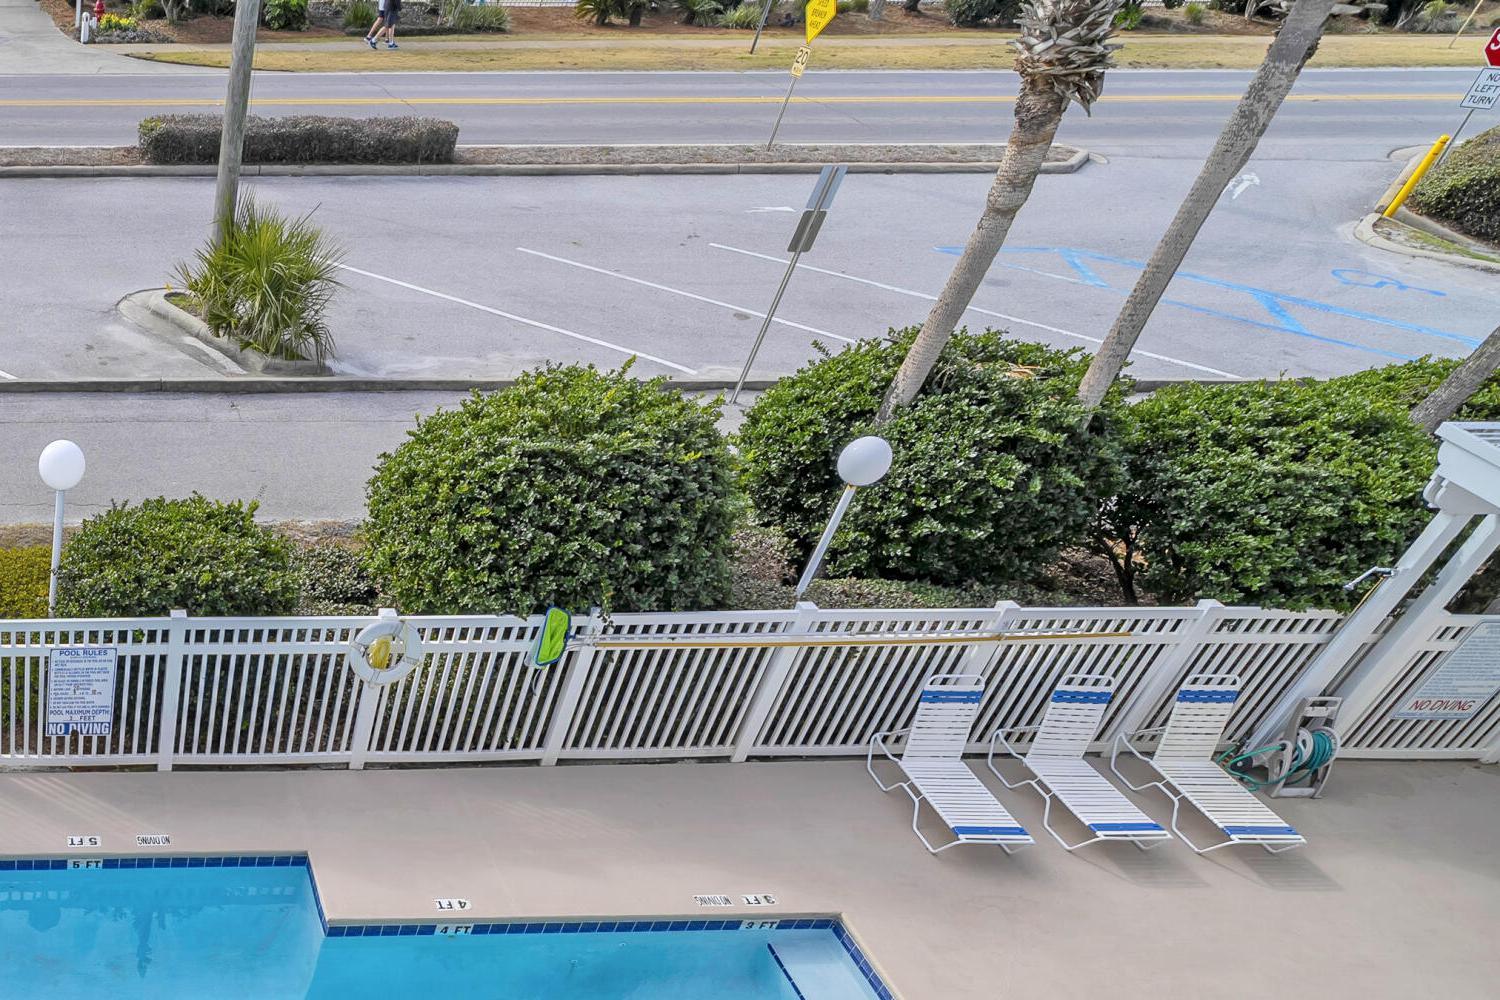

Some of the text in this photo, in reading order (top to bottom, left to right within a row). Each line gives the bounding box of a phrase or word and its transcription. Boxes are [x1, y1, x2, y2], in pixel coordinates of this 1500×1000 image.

[795, 49, 809, 65] 20
[1486, 73, 1500, 82] NO
[1474, 84, 1500, 94] LEFT
[1468, 95, 1494, 105] TURN
[1408, 699, 1477, 711] NO DIVING
[49, 722, 110, 735] NO DIVING
[88, 837, 98, 846] 5
[137, 835, 171, 846] NO DIVING
[73, 860, 100, 869] 5 FT
[457, 899, 467, 909] 4
[763, 895, 776, 904] 3
[440, 925, 472, 935] 4 FT
[745, 921, 778, 929] 3 FT
